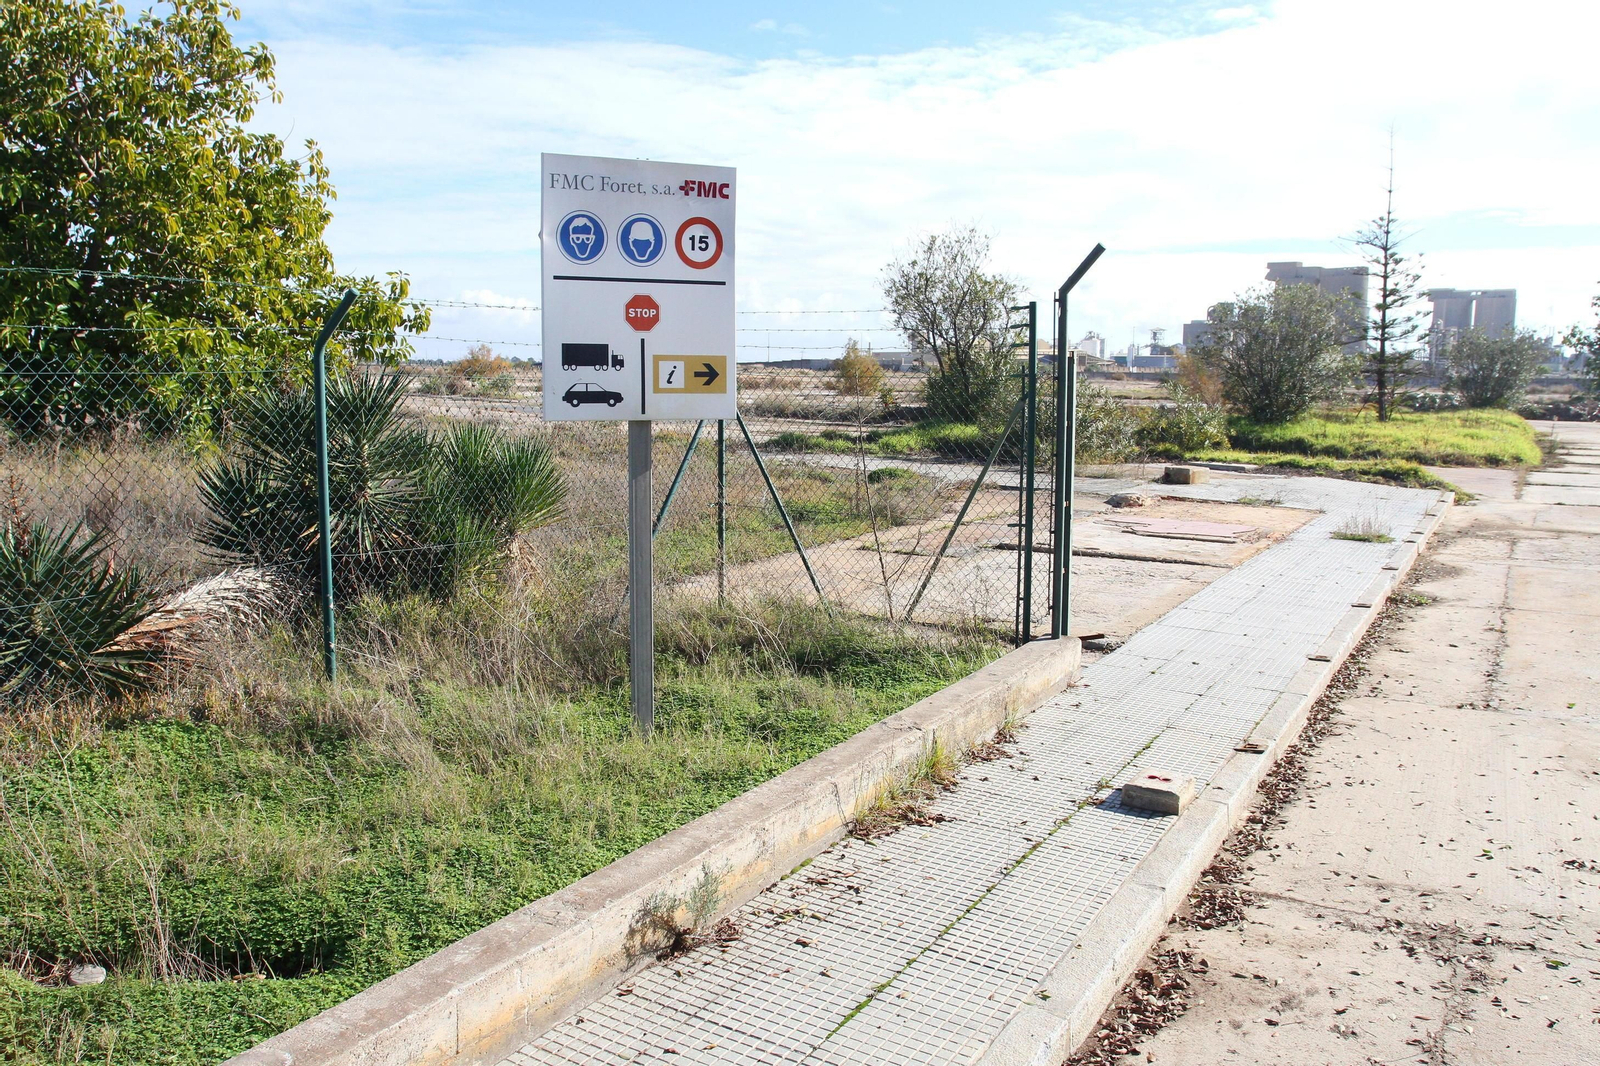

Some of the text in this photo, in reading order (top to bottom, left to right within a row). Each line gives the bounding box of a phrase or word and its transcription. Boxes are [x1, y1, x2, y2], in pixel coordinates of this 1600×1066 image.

[549, 173, 676, 196] FMC Foret, s.a.
[679, 179, 730, 200] FMC
[689, 235, 709, 252] 15
[628, 308, 657, 318] STOP
[666, 365, 677, 385] i
